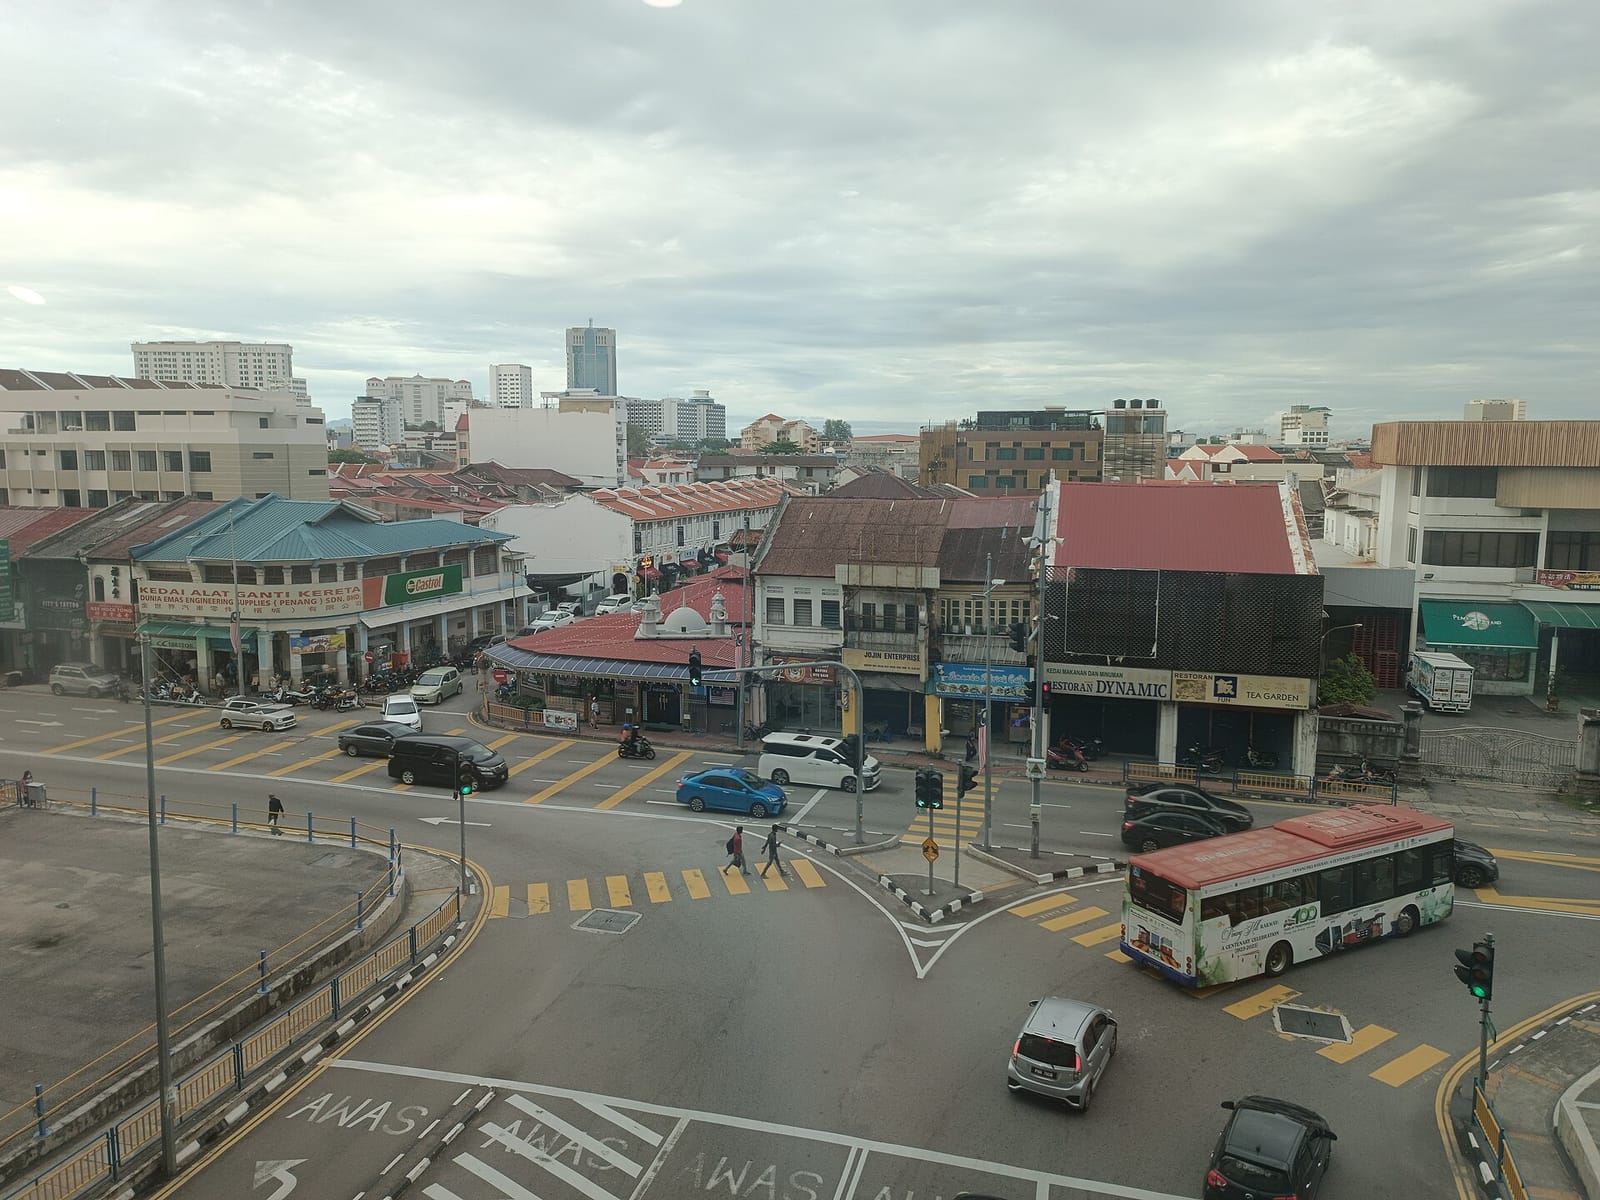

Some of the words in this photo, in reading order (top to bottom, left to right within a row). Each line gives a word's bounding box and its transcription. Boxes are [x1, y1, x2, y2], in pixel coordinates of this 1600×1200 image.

[415, 576, 442, 592] Castrol
[140, 587, 185, 596] KEDAI
[191, 589, 230, 598] ALAT
[299, 586, 361, 598] KERETA
[186, 597, 234, 605] ENGINEERING
[280, 598, 317, 606] PENANG
[864, 651, 882, 659] JOJIN
[1174, 672, 1213, 680] RESTORAN
[1048, 681, 1093, 693] ESTORAN
[1096, 680, 1167, 698] DYNAMIC
[1246, 691, 1262, 699] TEA
[1263, 692, 1299, 702] GARDEN
[1292, 906, 1317, 924] 100
[286, 1093, 429, 1136] AWAS
[480, 1119, 629, 1171] AWAS
